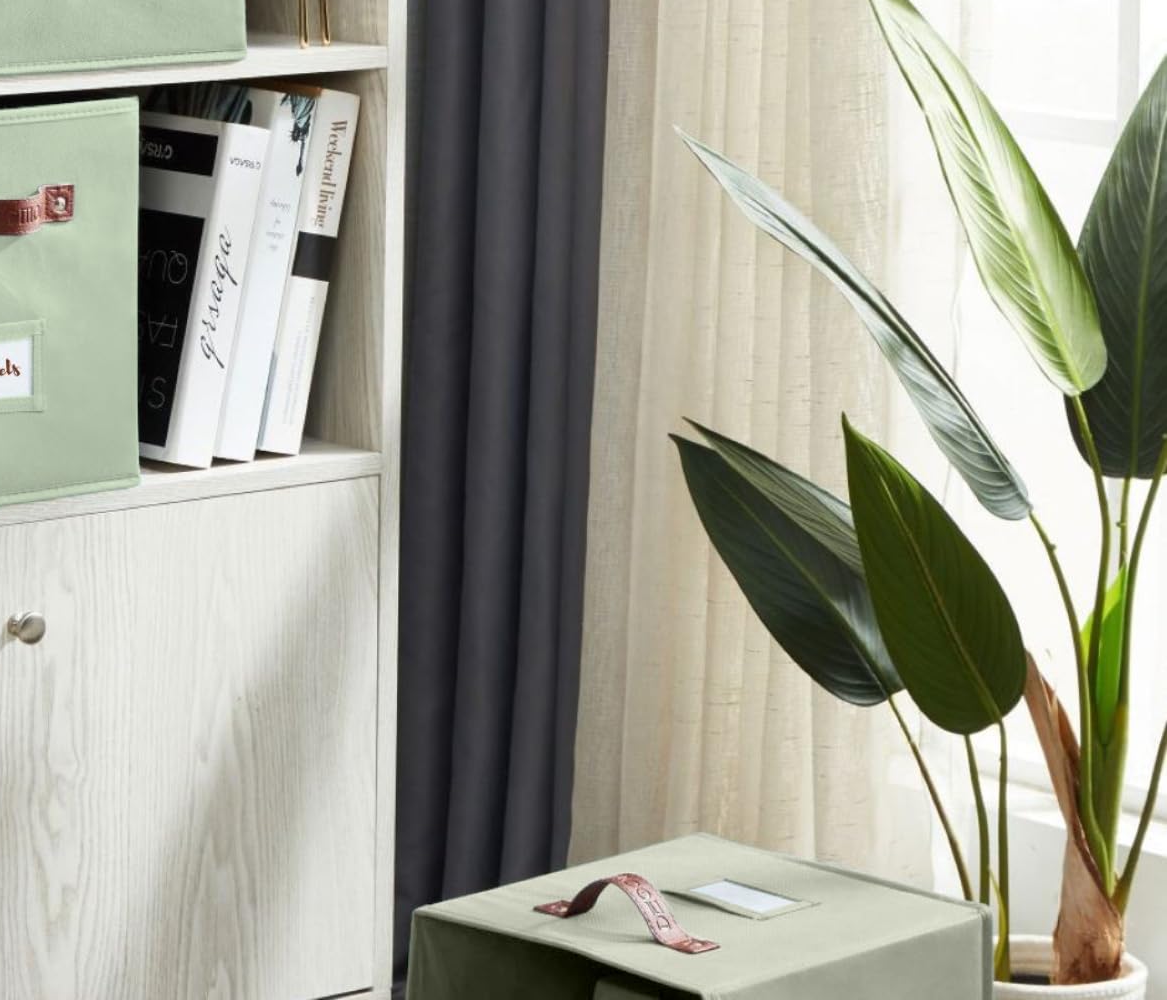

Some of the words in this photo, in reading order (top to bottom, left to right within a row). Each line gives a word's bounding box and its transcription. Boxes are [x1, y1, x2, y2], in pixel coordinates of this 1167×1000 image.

[321, 120, 348, 188] Weekend
[313, 190, 336, 228] living
[139, 249, 188, 285] QU
